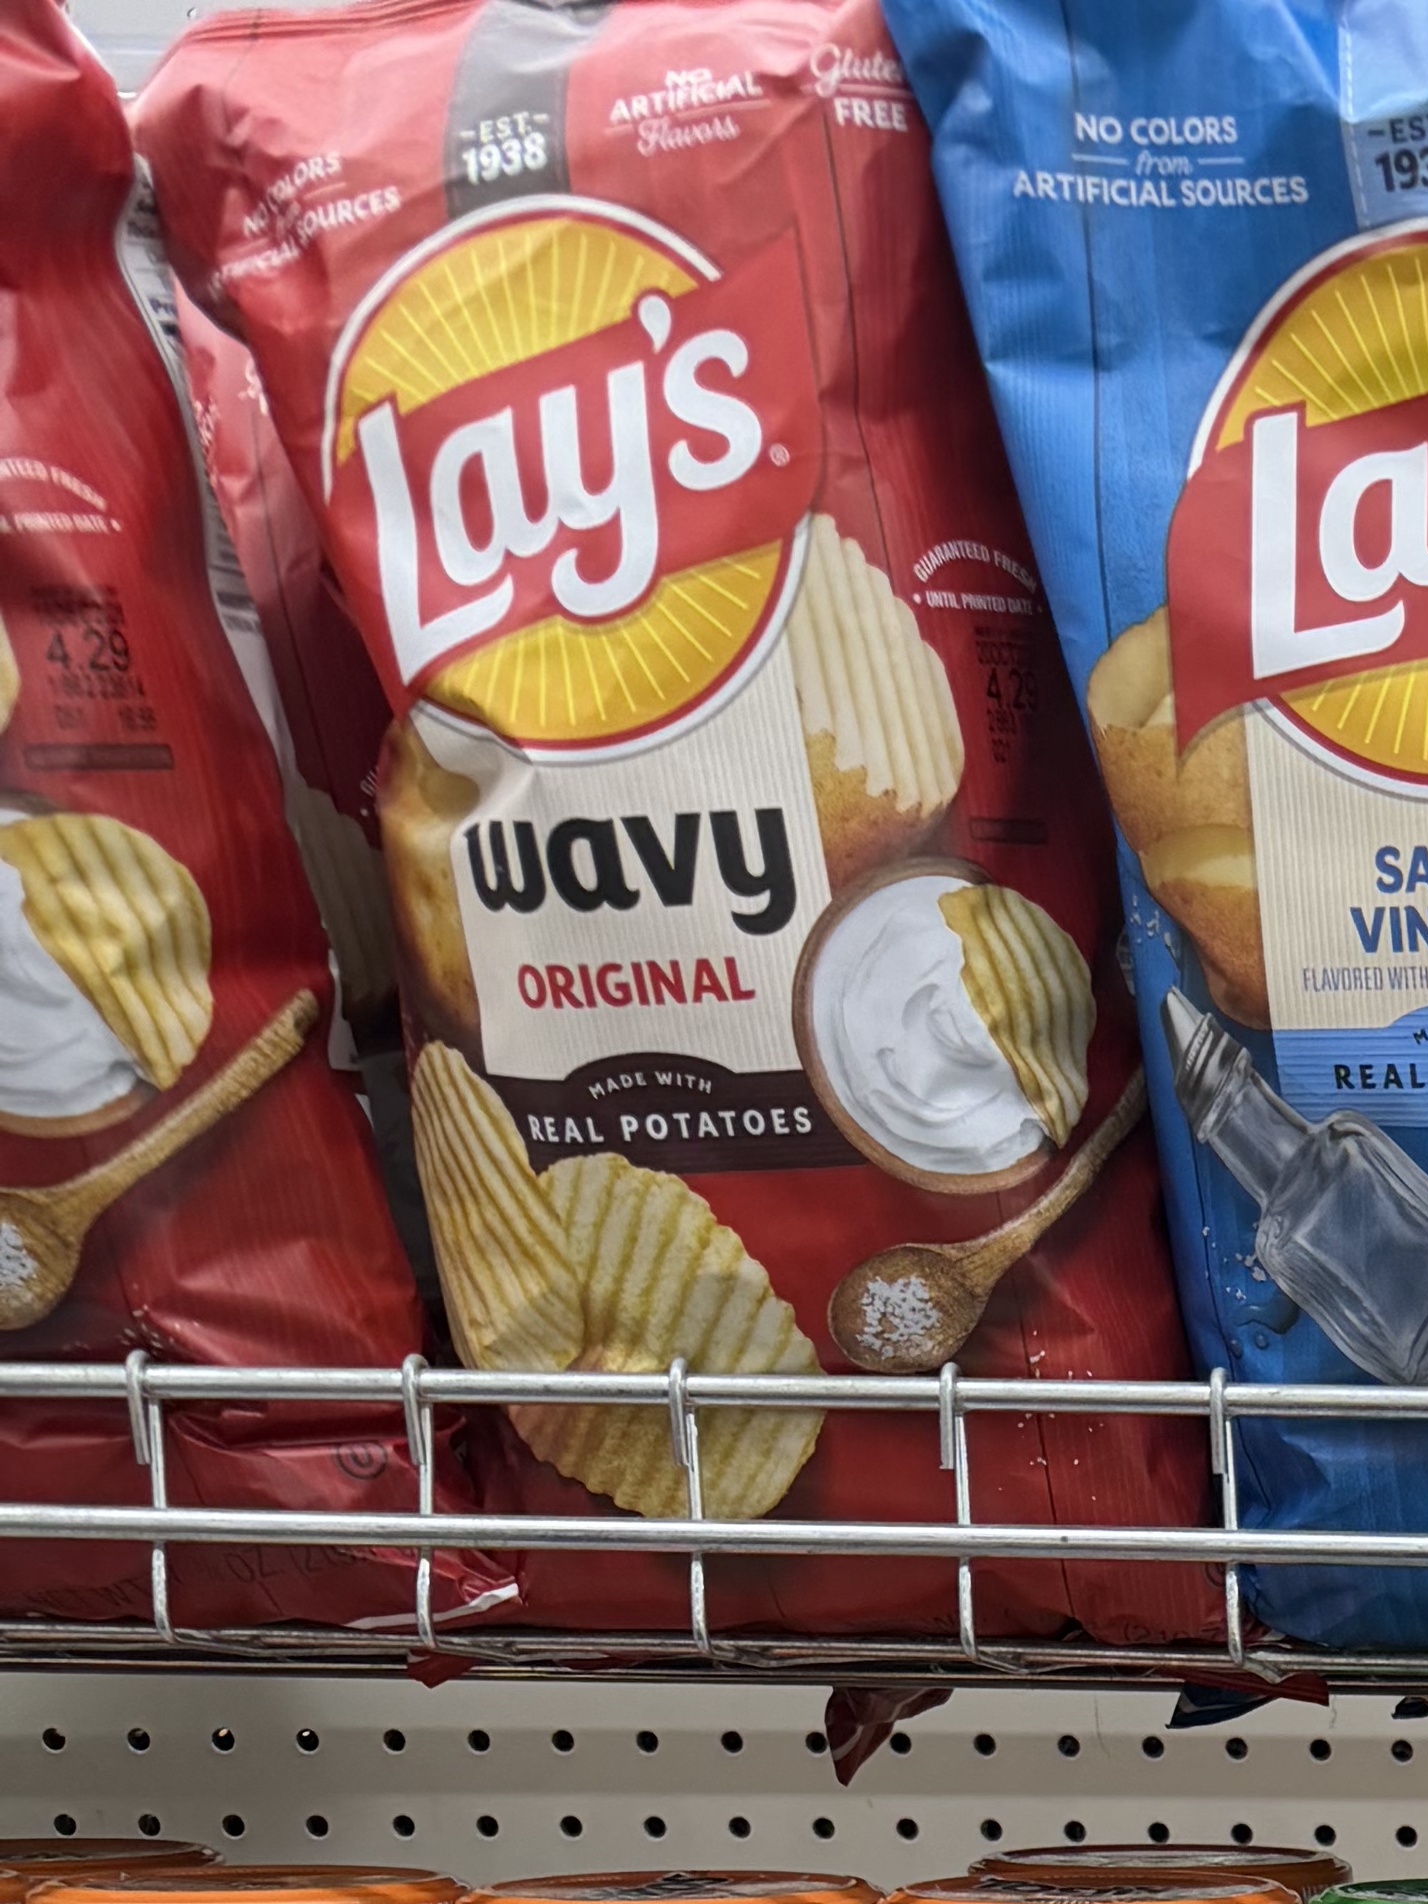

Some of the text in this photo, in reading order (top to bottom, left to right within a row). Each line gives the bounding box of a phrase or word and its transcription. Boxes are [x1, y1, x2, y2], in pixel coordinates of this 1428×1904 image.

[835, 98, 908, 131] FREE
[1074, 112, 1238, 145] NO COLORS
[461, 138, 547, 185] 1938
[1134, 150, 1194, 176] from
[1013, 171, 1308, 207] ARTIFICIAL SOURCES
[357, 295, 763, 688] Lay's
[466, 808, 799, 935] wavy
[518, 956, 756, 1010] ORIGINAL
[1302, 966, 1383, 994] FLAVORED
[1389, 964, 1428, 992] WITH
[1333, 1062, 1427, 1091] REAL
[530, 1106, 813, 1145] REAL POTATOES
